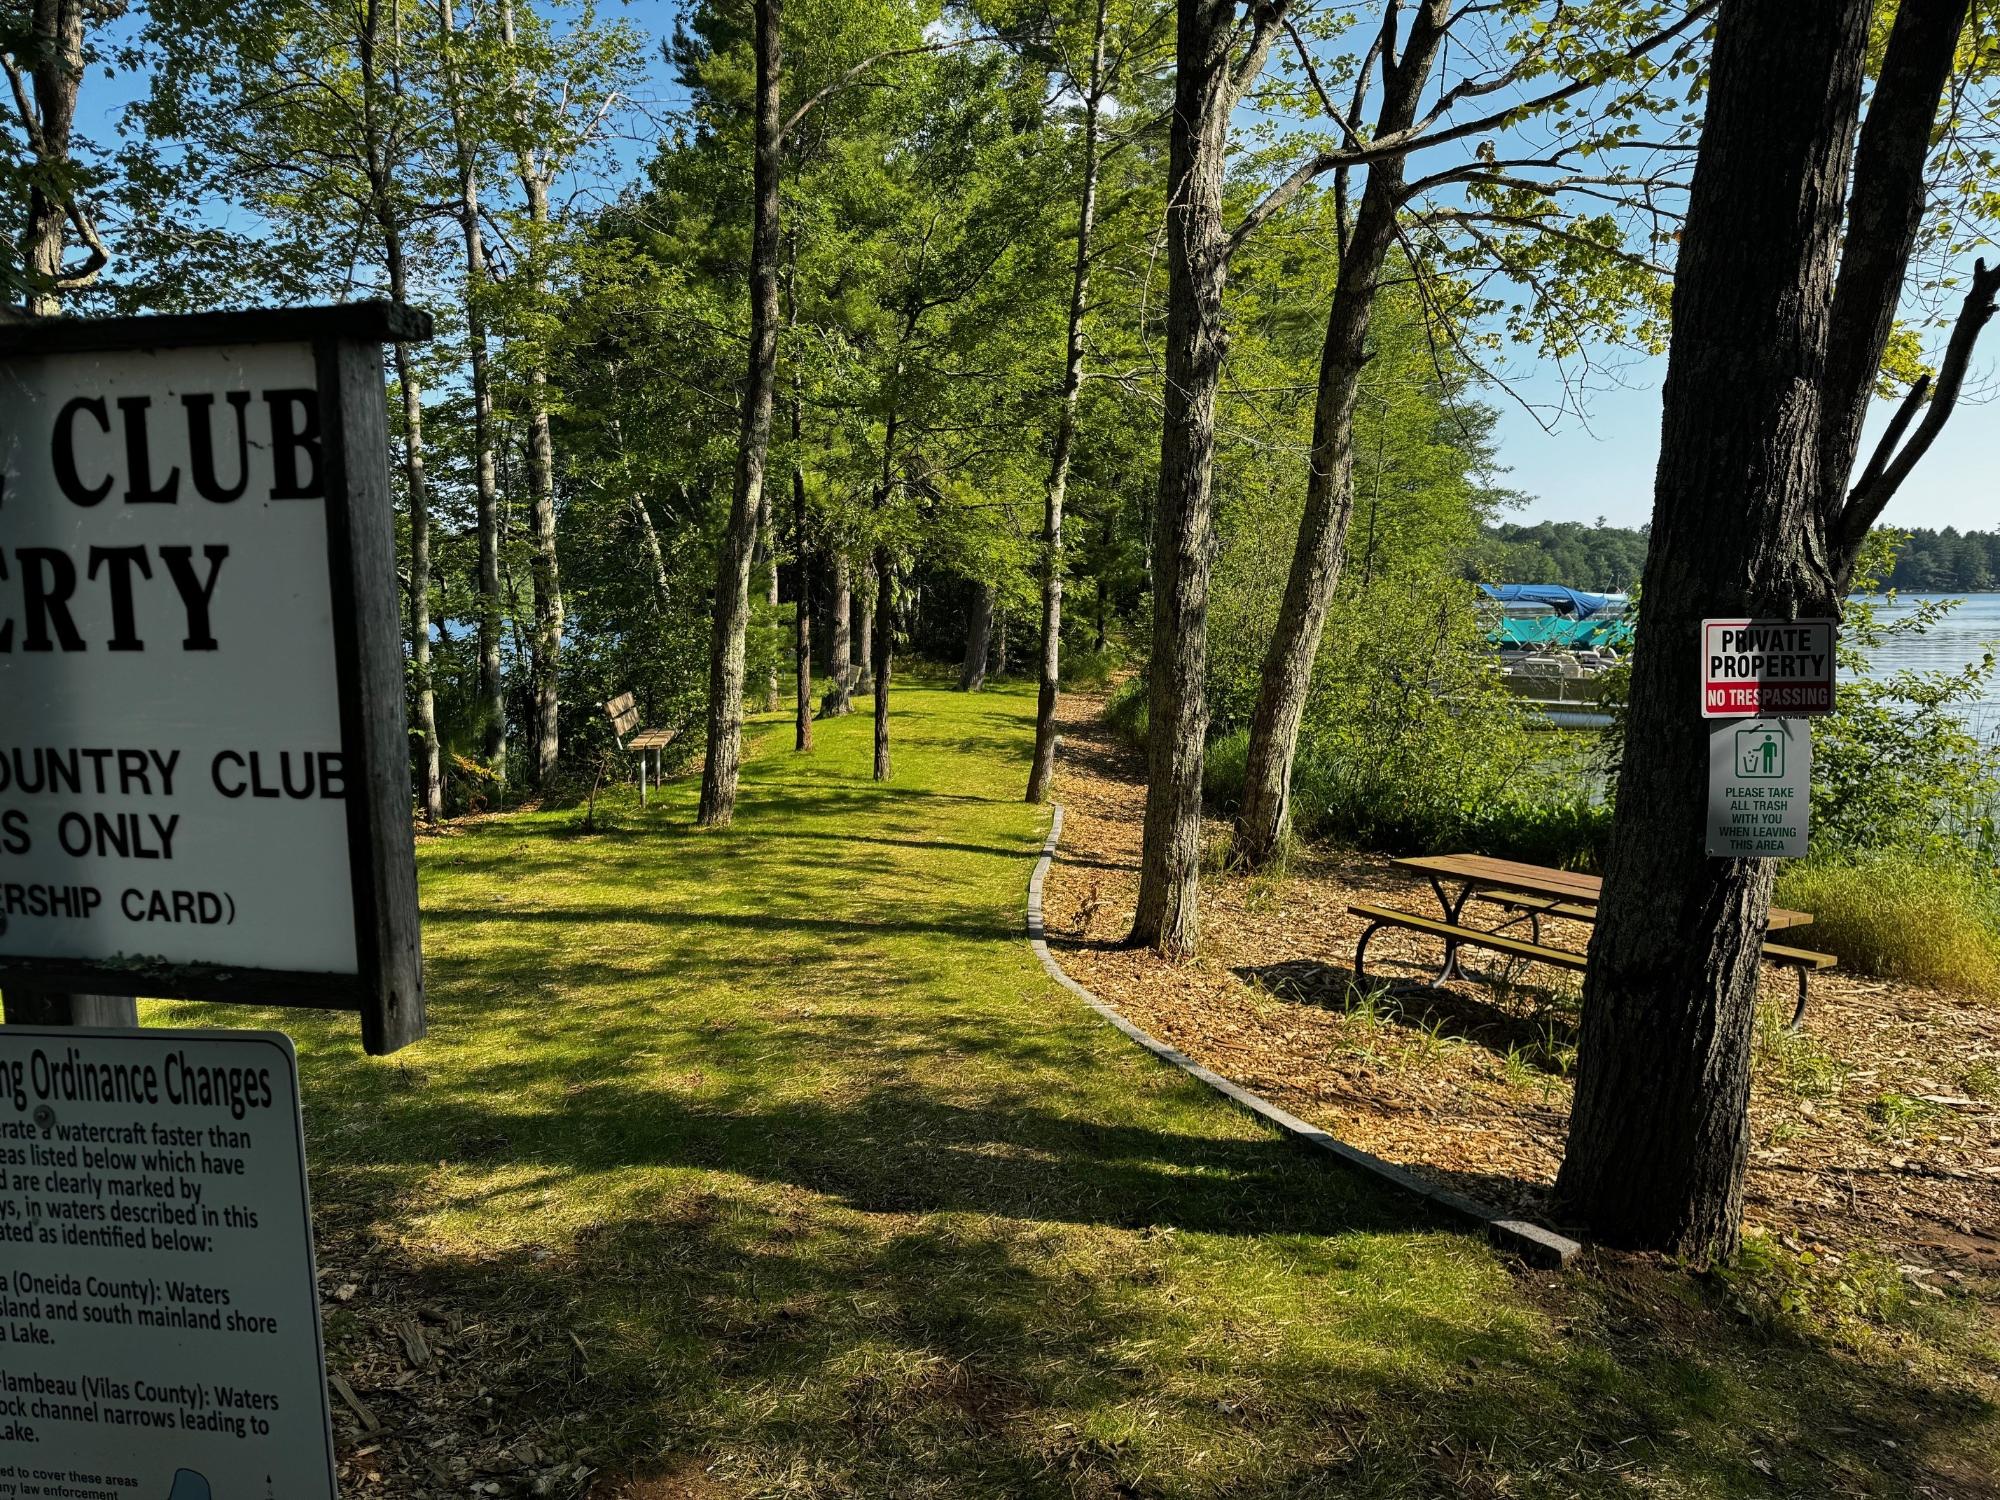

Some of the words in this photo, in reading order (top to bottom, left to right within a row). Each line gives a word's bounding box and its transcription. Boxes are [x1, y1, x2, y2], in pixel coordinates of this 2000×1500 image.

[51, 388, 326, 508] CLUB
[1722, 629, 1811, 652] PRIVATE
[1711, 654, 1825, 678] PROPERTY
[1708, 689, 1725, 706] NO
[1729, 688, 1828, 706] TRESPASSING
[210, 750, 346, 799] CLUB
[1725, 787, 1764, 798] PLEASE
[1768, 787, 1794, 798] TAKE
[1730, 800, 1749, 811] ALL
[1753, 800, 1787, 811] TRASH
[1720, 826, 1749, 837] WHEN
[1753, 826, 1797, 837] LEAVING
[1732, 813, 1758, 824] WITH
[1762, 813, 1782, 824] YOU
[58, 811, 179, 859] ONLY
[1730, 839, 1753, 850] THIS
[1756, 839, 1784, 850] AREA
[0, 883, 102, 918] RSHIP
[120, 888, 235, 925] CARD)
[31, 1047, 158, 1104] Ordinance
[164, 1050, 272, 1120] Changes
[0, 1119, 36, 1140] rate
[56, 1121, 147, 1145] watercraft
[152, 1123, 203, 1147] faster
[209, 1125, 251, 1149] than
[30, 1144, 78, 1168] listed
[82, 1145, 136, 1170] below
[142, 1147, 196, 1174] which
[202, 1151, 245, 1175] have
[12, 1174, 40, 1192] are
[45, 1170, 102, 1200] clearly
[108, 1175, 175, 1200] marked
[180, 1177, 202, 1204] by
[25, 1195, 42, 1217] in
[46, 1200, 105, 1221] waters
[110, 1199, 197, 1226] described
[203, 1204, 219, 1227] in
[224, 1206, 259, 1229] this
[39, 1227, 58, 1244] as
[61, 1223, 147, 1249] identified
[151, 1228, 214, 1252] below:
[13, 1270, 82, 1297] (Oneida
[86, 1276, 162, 1304] County):
[166, 1281, 231, 1305] Waters
[46, 1299, 78, 1321] and
[82, 1303, 133, 1325] south
[138, 1306, 222, 1331] mainland
[227, 1310, 278, 1334] shore
[11, 1322, 55, 1345] Lake.
[0, 1370, 77, 1396] lambeau
[82, 1375, 130, 1401] (Vilas
[134, 1381, 211, 1409] County):
[214, 1386, 280, 1411] Waters
[31, 1397, 99, 1423] channel
[104, 1407, 176, 1430] narrows
[180, 1408, 247, 1439] leading
[251, 1415, 270, 1437] to
[18, 1467, 29, 1478] to
[33, 1470, 66, 1481] cover
[69, 1471, 102, 1485] these
[106, 1475, 139, 1488] areas
[20, 1483, 40, 1495] law
[43, 1485, 119, 1500] enforcement
